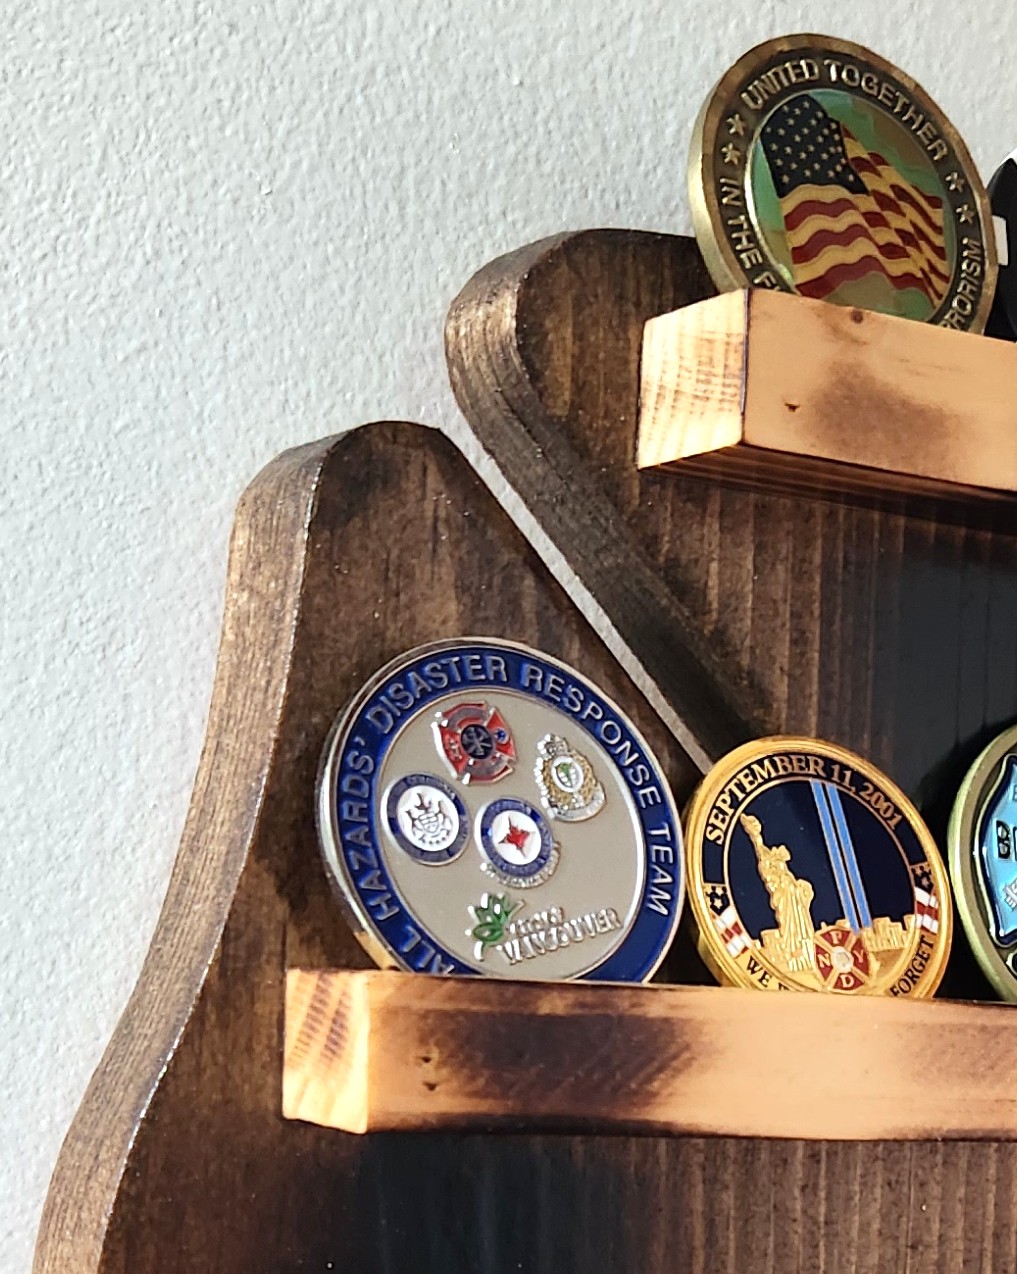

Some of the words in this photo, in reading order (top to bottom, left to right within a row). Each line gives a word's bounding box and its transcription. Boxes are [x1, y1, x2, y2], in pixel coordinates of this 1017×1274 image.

[741, 58, 820, 111] UNITED
[824, 58, 949, 161] TOGETHER
[719, 177, 743, 208] IN
[727, 214, 763, 270] THE
[366, 654, 508, 736] DISASTER
[520, 662, 663, 811] RESPONSE
[342, 736, 400, 922] HAZARDS'
[706, 753, 827, 846] SEPTEMBER
[859, 781, 905, 830] 2001
[646, 821, 677, 917] TEAM
[403, 926, 456, 977] ALL
[746, 956, 773, 987] WE
[889, 934, 935, 997] FORGET
